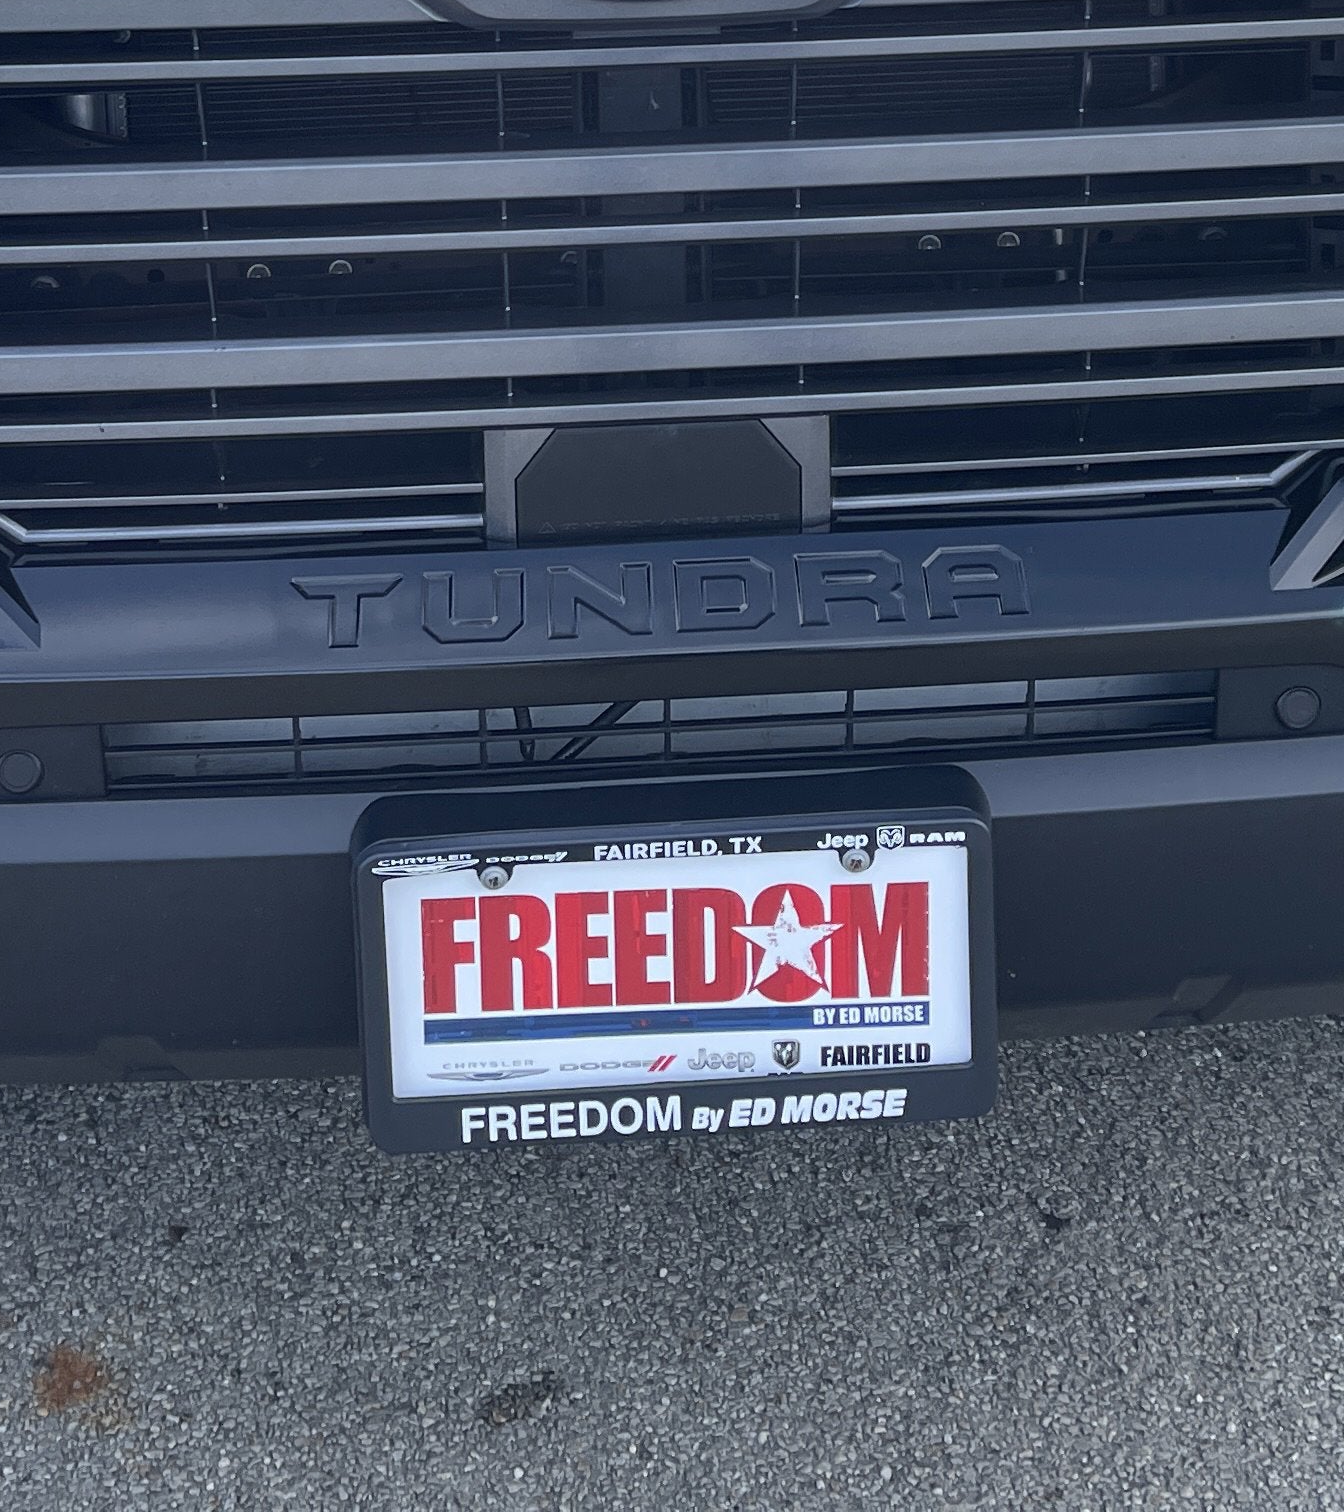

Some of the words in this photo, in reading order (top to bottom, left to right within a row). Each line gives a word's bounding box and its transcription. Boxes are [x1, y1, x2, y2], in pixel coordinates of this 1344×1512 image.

[289, 543, 1032, 649] TUNDRA
[728, 836, 762, 854] TX
[817, 832, 869, 850] Jeep
[909, 831, 966, 844] RAM
[377, 852, 472, 868] CHRYSLER
[420, 881, 930, 1015] FREEDOM
[813, 1007, 835, 1026] BY
[839, 1006, 861, 1024] ED
[864, 1004, 925, 1024] MORSE
[442, 1059, 534, 1071] CHRYSLER
[687, 1048, 755, 1073] Jeep
[820, 1042, 932, 1067] FAIRFIELD
[461, 1094, 682, 1144] FREEDOM
[691, 1106, 724, 1133] By
[728, 1096, 776, 1128] ED
[780, 1088, 907, 1125] MORSE
